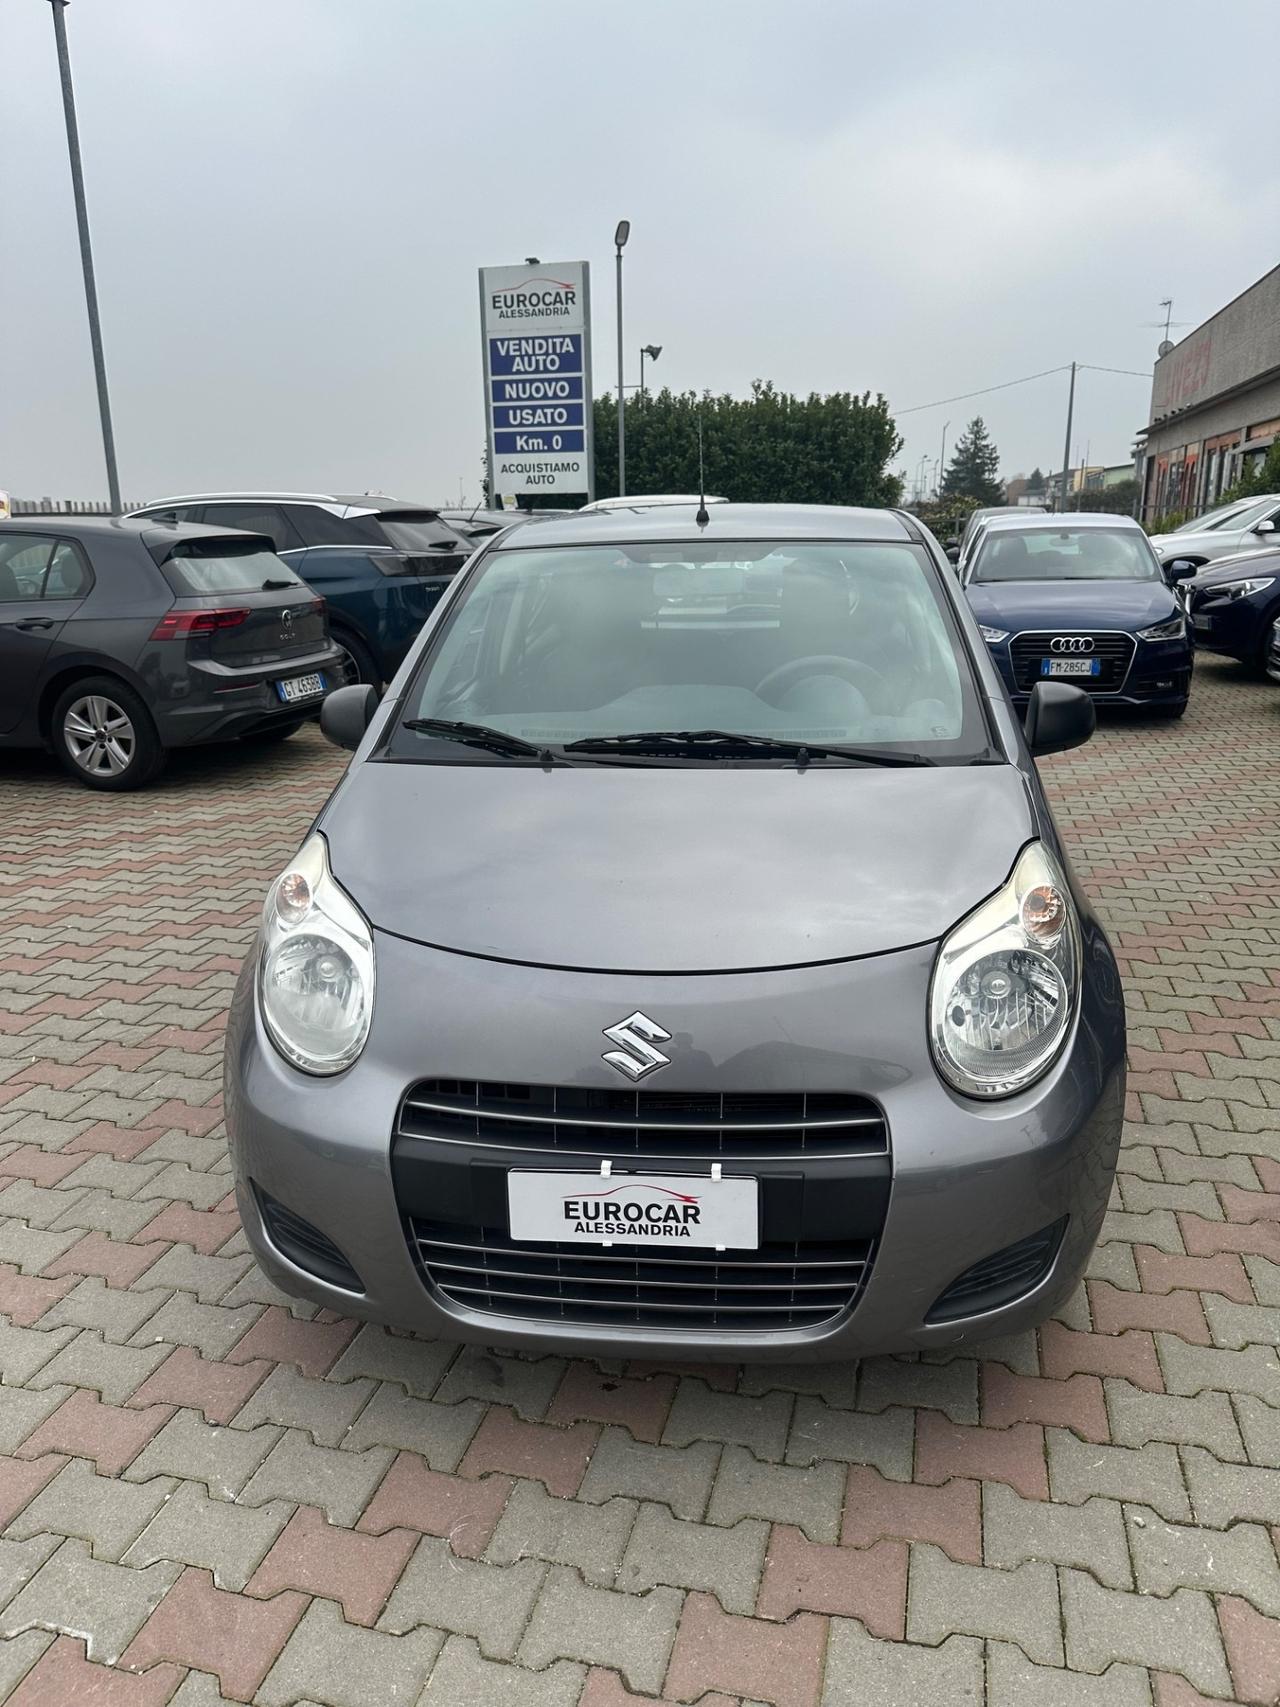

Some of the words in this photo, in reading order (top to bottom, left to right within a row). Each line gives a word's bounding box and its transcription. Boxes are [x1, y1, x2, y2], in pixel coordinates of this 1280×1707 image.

[492, 291, 576, 309] EUROCAR
[498, 307, 570, 319] ALESSANDRIA
[497, 337, 574, 356] VENDITA
[512, 354, 560, 372] AUTO
[504, 381, 570, 399] NUOVO
[509, 407, 568, 425] USATO
[516, 436, 548, 451] Km.
[552, 435, 562, 450] 0
[500, 462, 580, 474] ACQUISTIAMO
[525, 474, 556, 485] AUTO
[563, 1201, 701, 1225] EUROCAR
[574, 1222, 691, 1237] ALESSANDRIA
